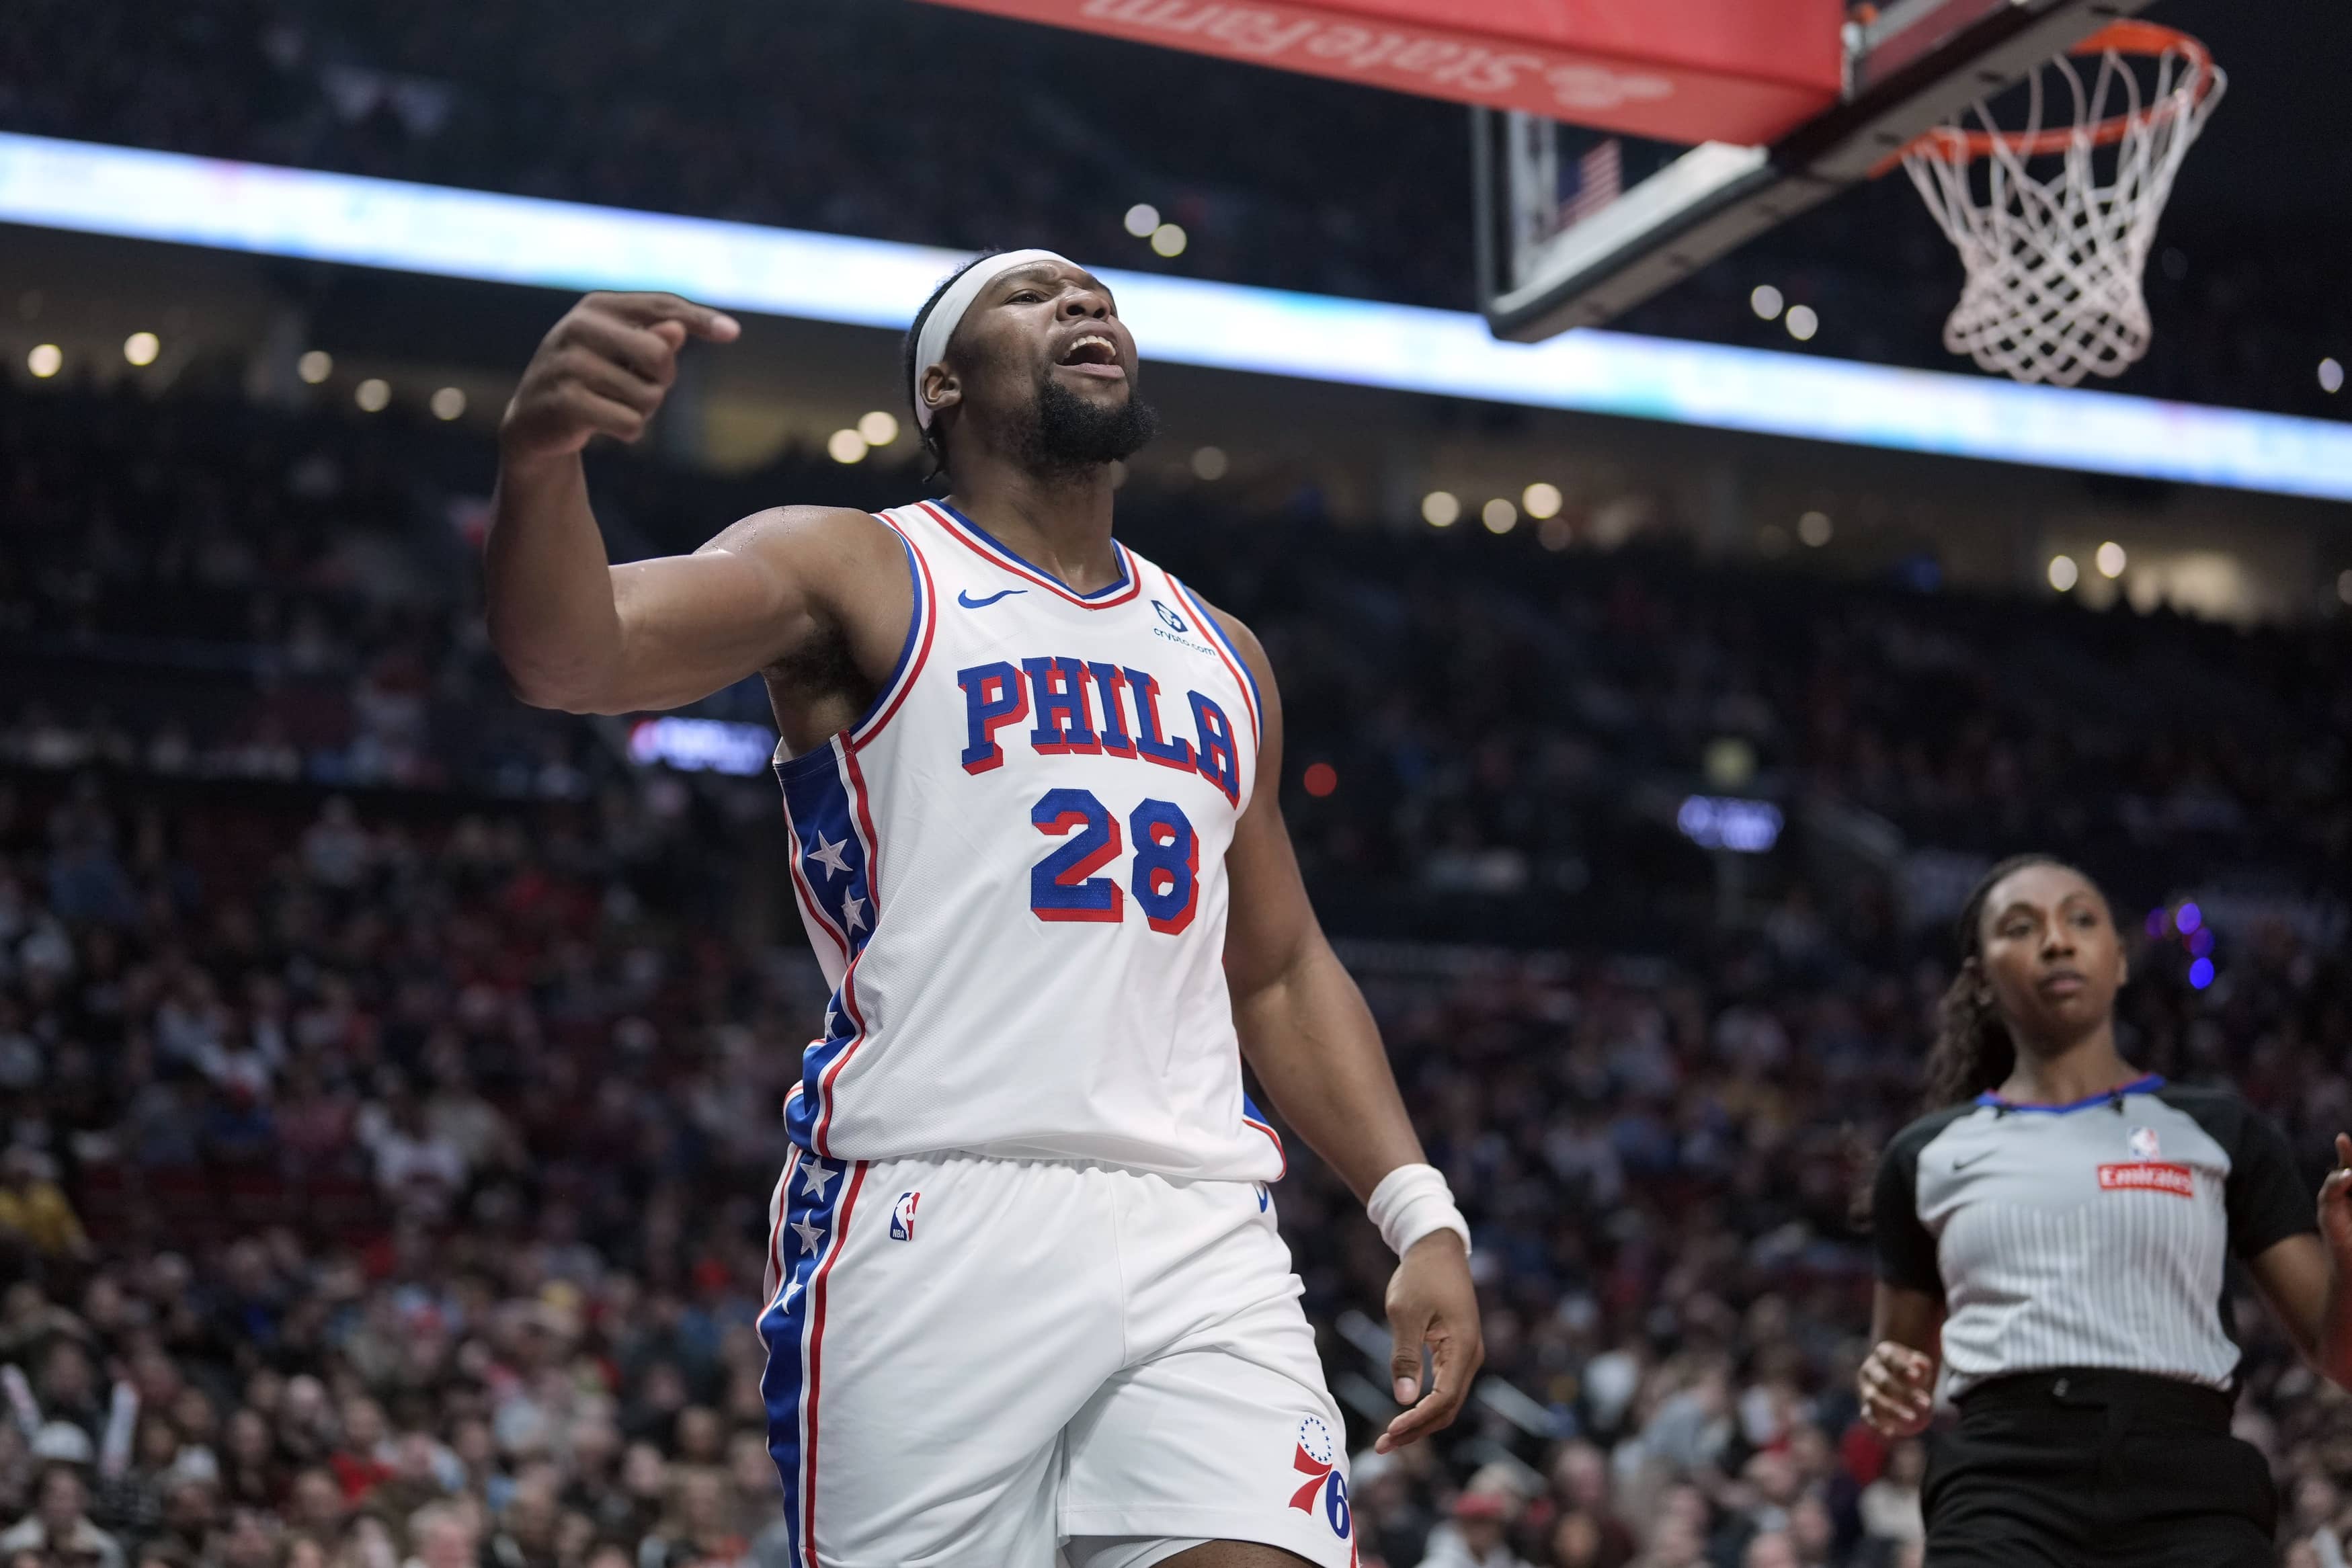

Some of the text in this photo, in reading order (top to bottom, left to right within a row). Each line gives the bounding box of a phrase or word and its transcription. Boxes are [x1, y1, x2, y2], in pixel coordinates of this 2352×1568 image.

[1153, 628, 1216, 656] crypto.com
[957, 656, 1240, 810] PHILA
[1031, 788, 1199, 936] 28
[893, 1229, 905, 1239] NBA
[1289, 1441, 1350, 1539] 76
